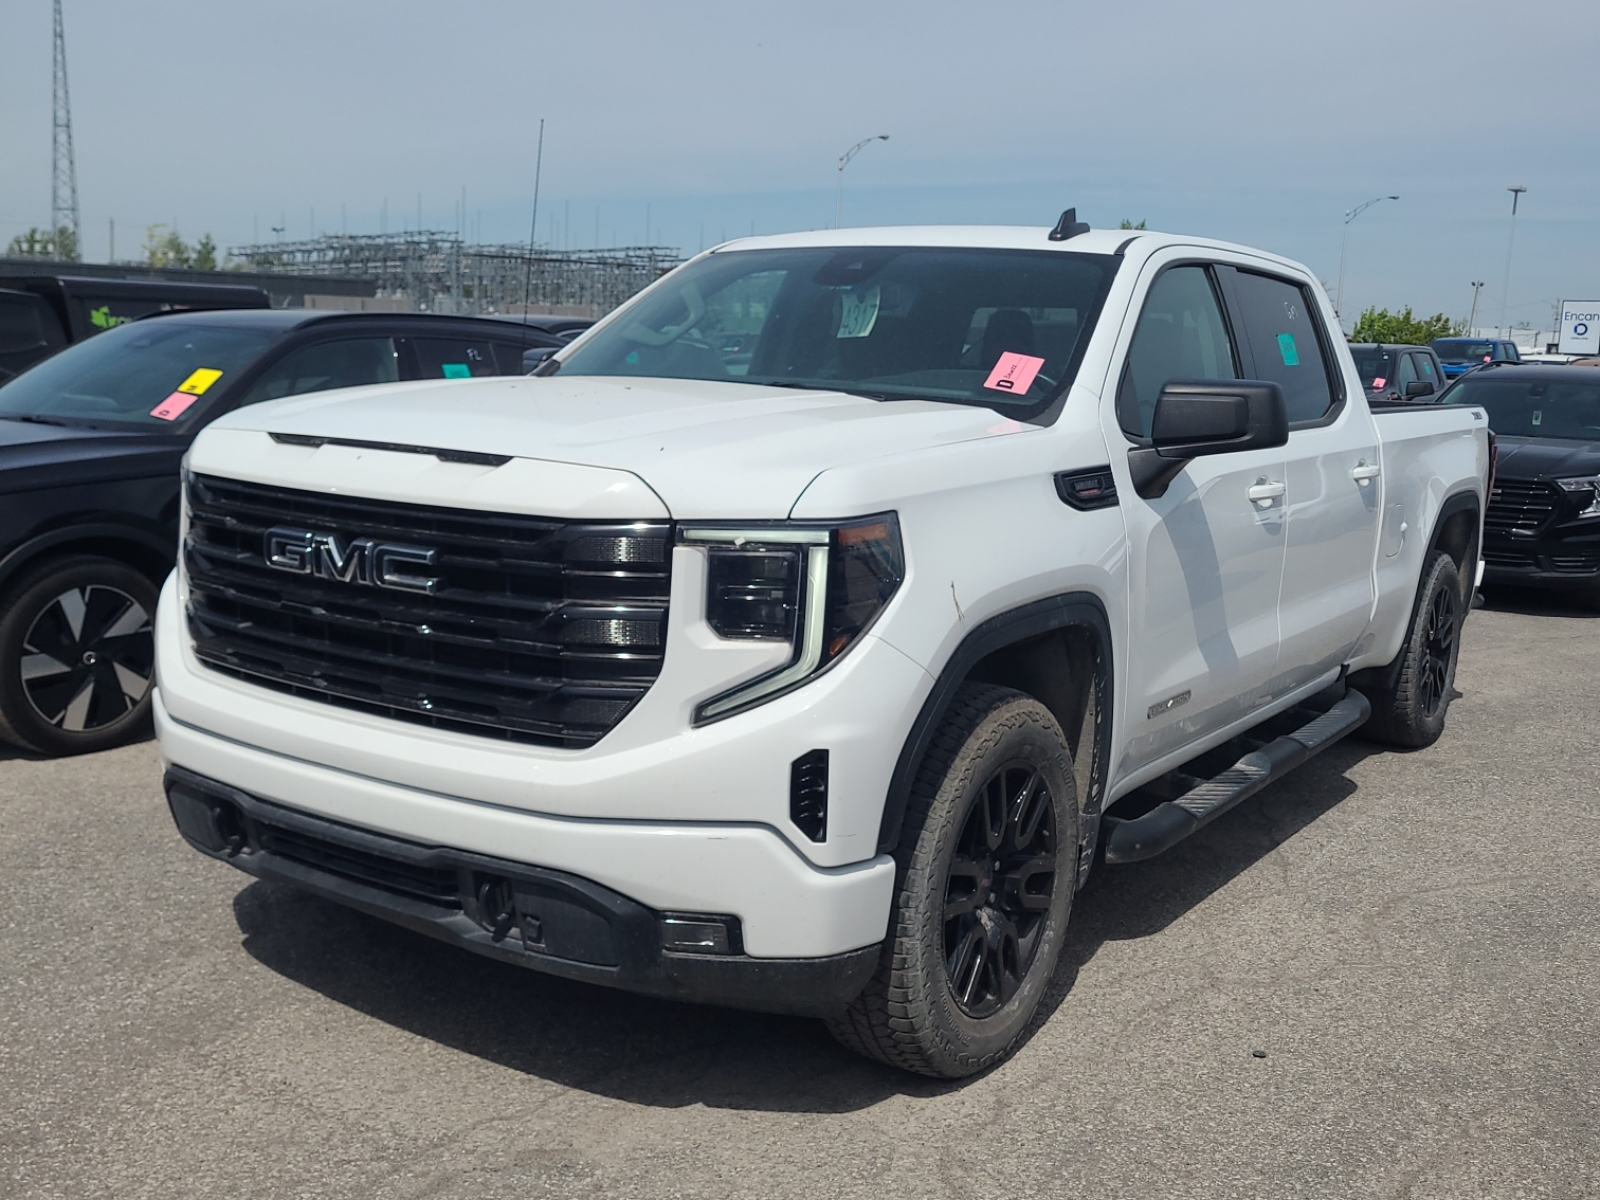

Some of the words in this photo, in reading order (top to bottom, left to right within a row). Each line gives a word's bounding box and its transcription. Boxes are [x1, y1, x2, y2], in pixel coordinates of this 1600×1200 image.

[1564, 311, 1600, 321] Encan
[996, 379, 1015, 390] D
[264, 525, 437, 597] GMC
